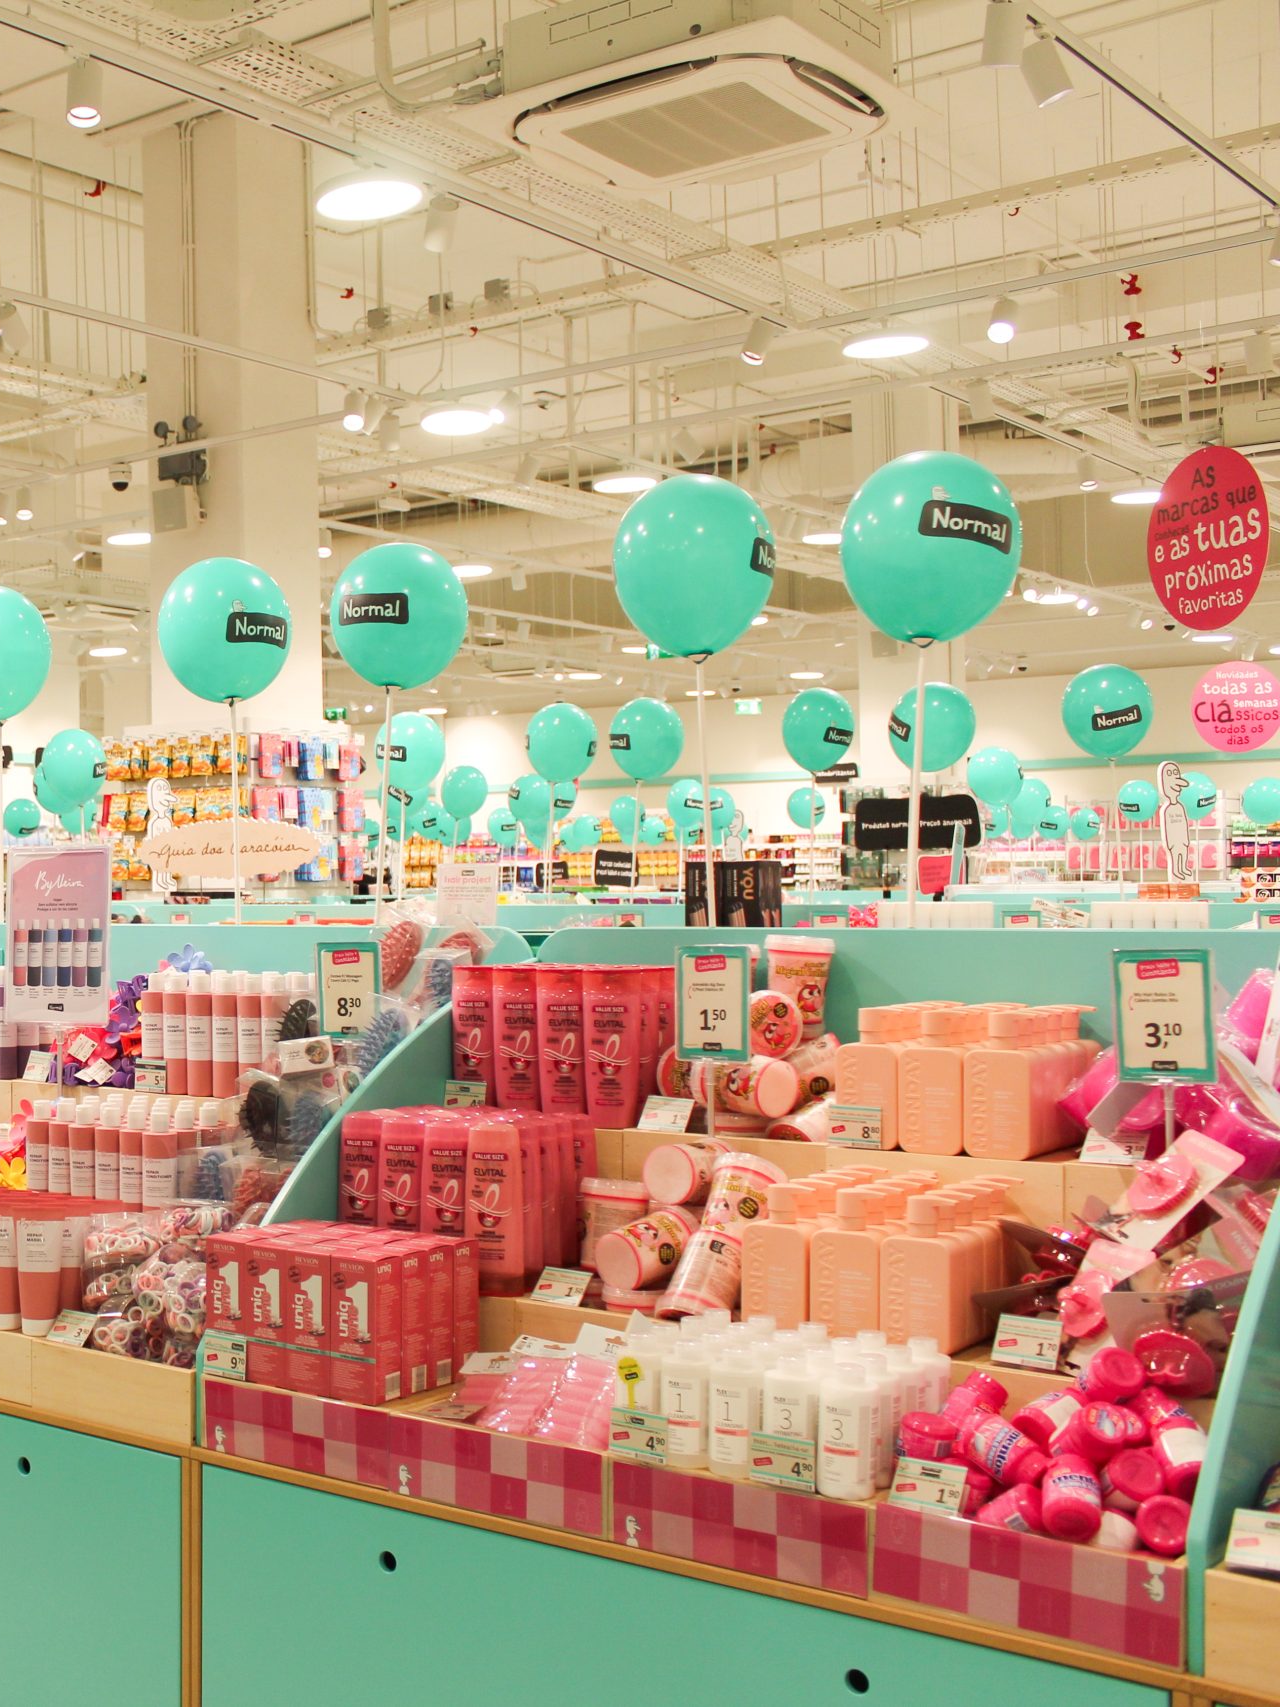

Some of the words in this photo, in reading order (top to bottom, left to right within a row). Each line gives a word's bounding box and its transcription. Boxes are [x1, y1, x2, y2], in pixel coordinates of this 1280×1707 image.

[1157, 491, 1220, 525] marcas
[1225, 484, 1257, 512] que
[931, 505, 1007, 544] Normal
[1154, 544, 1165, 563] e
[1169, 535, 1190, 561] as
[1193, 507, 1262, 552] tuas
[758, 544, 777, 569] Nor
[1164, 553, 1253, 599] próximas
[343, 600, 401, 618] Normal
[1178, 587, 1244, 615] favoritas
[235, 617, 285, 641] Normal
[1215, 669, 1259, 680] Novidades
[1202, 681, 1248, 696] todas
[1254, 681, 1273, 695] as
[1233, 697, 1279, 708] semanas
[1097, 709, 1138, 728] Normal
[1214, 724, 1247, 735] todos
[1251, 724, 1264, 734] os
[1226, 734, 1250, 746] dias
[458, 1014, 487, 1022] ELVITAL
[504, 1016, 536, 1025] ELVITAL
[548, 1018, 580, 1027] ELVITAL
[593, 1020, 626, 1028] ELVITAL
[345, 1153, 375, 1163] ELVITAL
[386, 1159, 417, 1169] ELVITAL
[431, 1164, 464, 1173] ELVITAL
[474, 1168, 506, 1178] ELVITAL
[429, 1252, 444, 1263] uniq
[456, 1246, 470, 1257] uniq
[376, 1262, 392, 1275] uniq
[403, 1257, 418, 1270] uniq
[213, 1279, 225, 1315] uniq
[219, 1261, 239, 1317] 1
[259, 1268, 280, 1325] 1
[250, 1287, 265, 1323] uniq
[294, 1294, 307, 1330] uniq
[300, 1275, 322, 1332] 1
[345, 1281, 368, 1340] 1
[338, 1300, 352, 1338] uniq
[779, 1408, 793, 1430] 3
[831, 1418, 844, 1441] 3
[994, 1429, 1021, 1477] mentos
